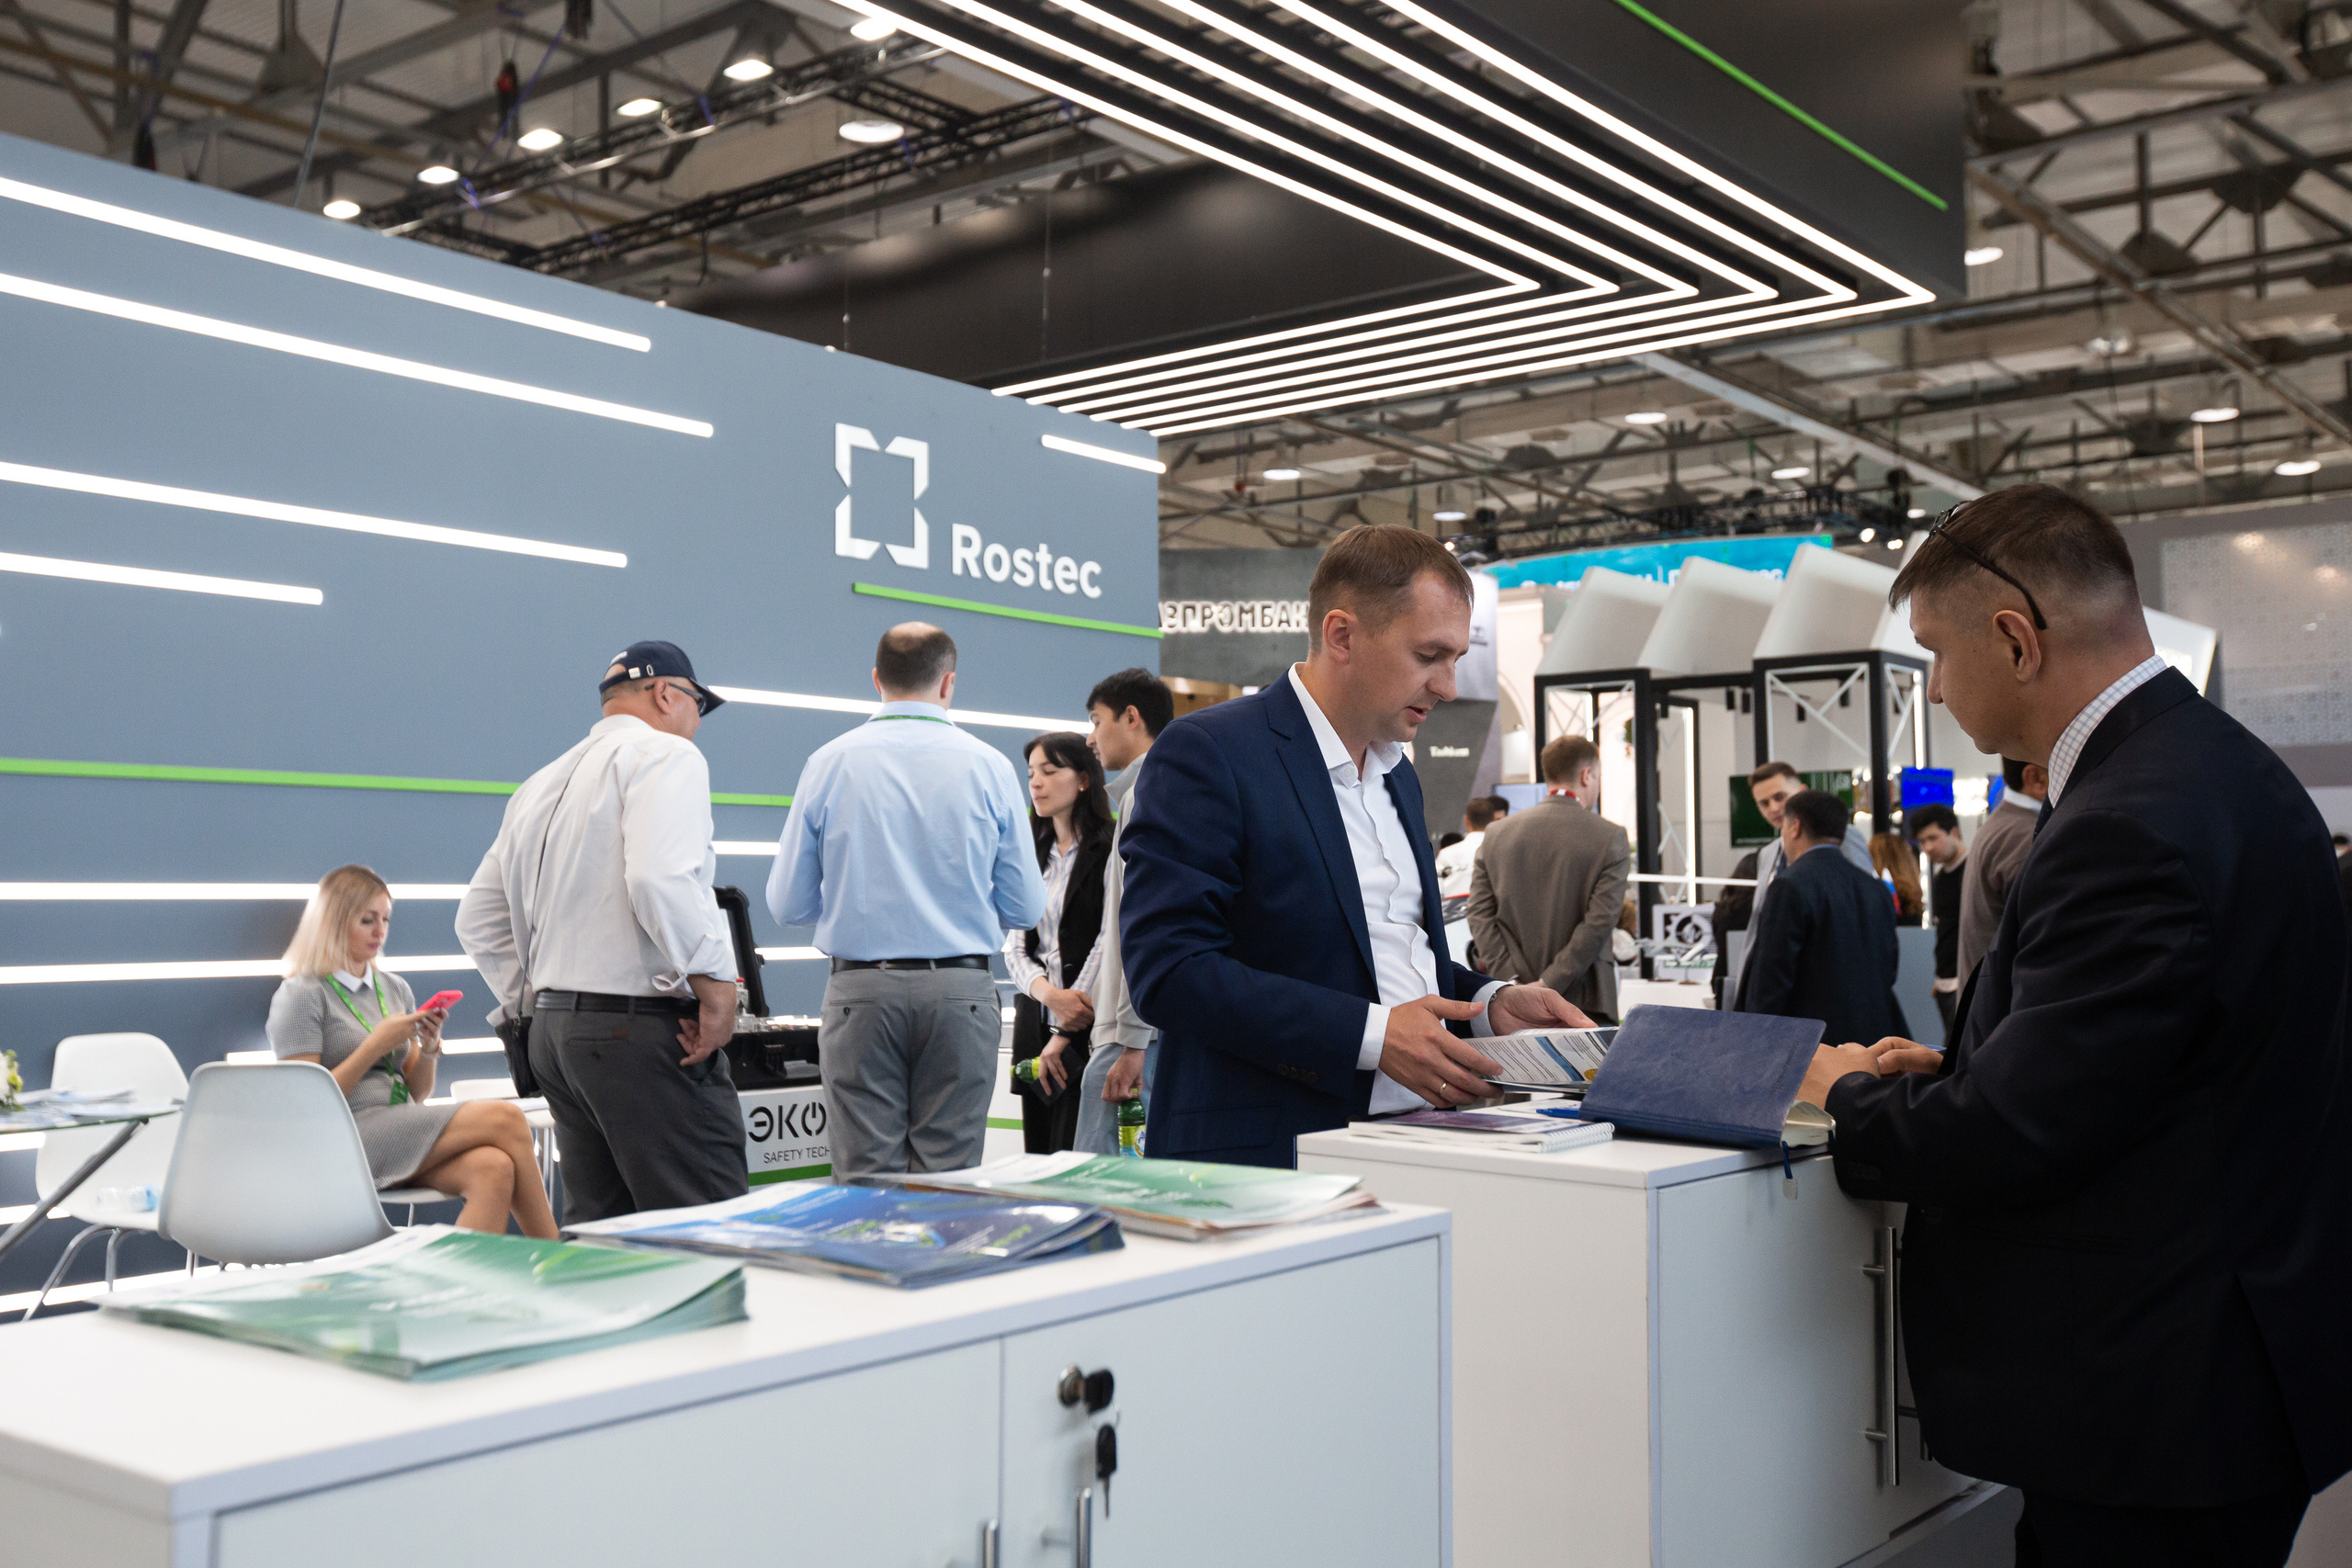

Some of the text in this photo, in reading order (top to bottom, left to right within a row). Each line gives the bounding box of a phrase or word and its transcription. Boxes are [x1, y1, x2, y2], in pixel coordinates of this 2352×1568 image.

[952, 523, 1102, 598] Rostec
[748, 1102, 827, 1143] ЭКО
[763, 1148, 803, 1164] SAFETY
